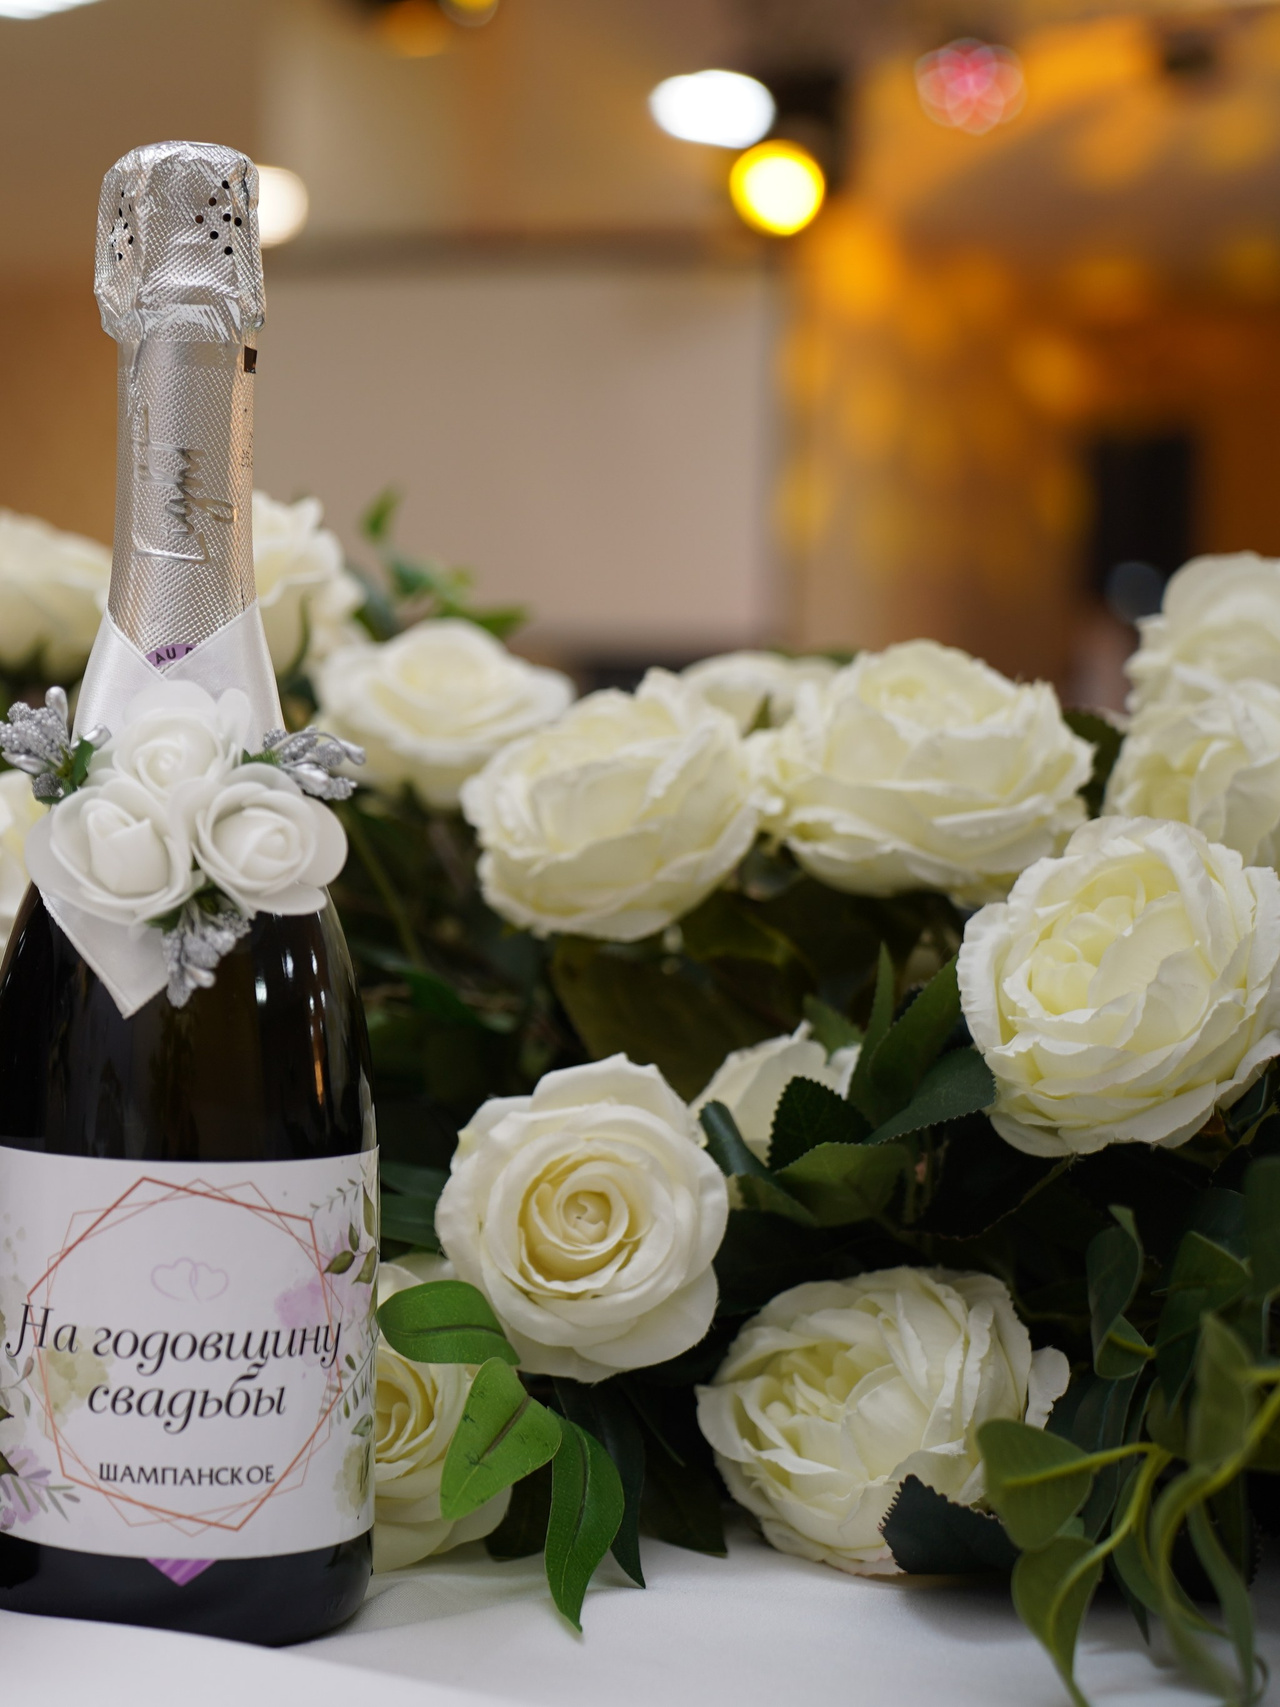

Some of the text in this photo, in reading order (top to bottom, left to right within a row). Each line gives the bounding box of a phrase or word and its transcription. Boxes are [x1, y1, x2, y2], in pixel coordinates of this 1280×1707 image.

[5, 1303, 342, 1377] На годовщину
[87, 1371, 286, 1435] свадьбы
[99, 1463, 276, 1486] ШАМПАНСКОЕ
